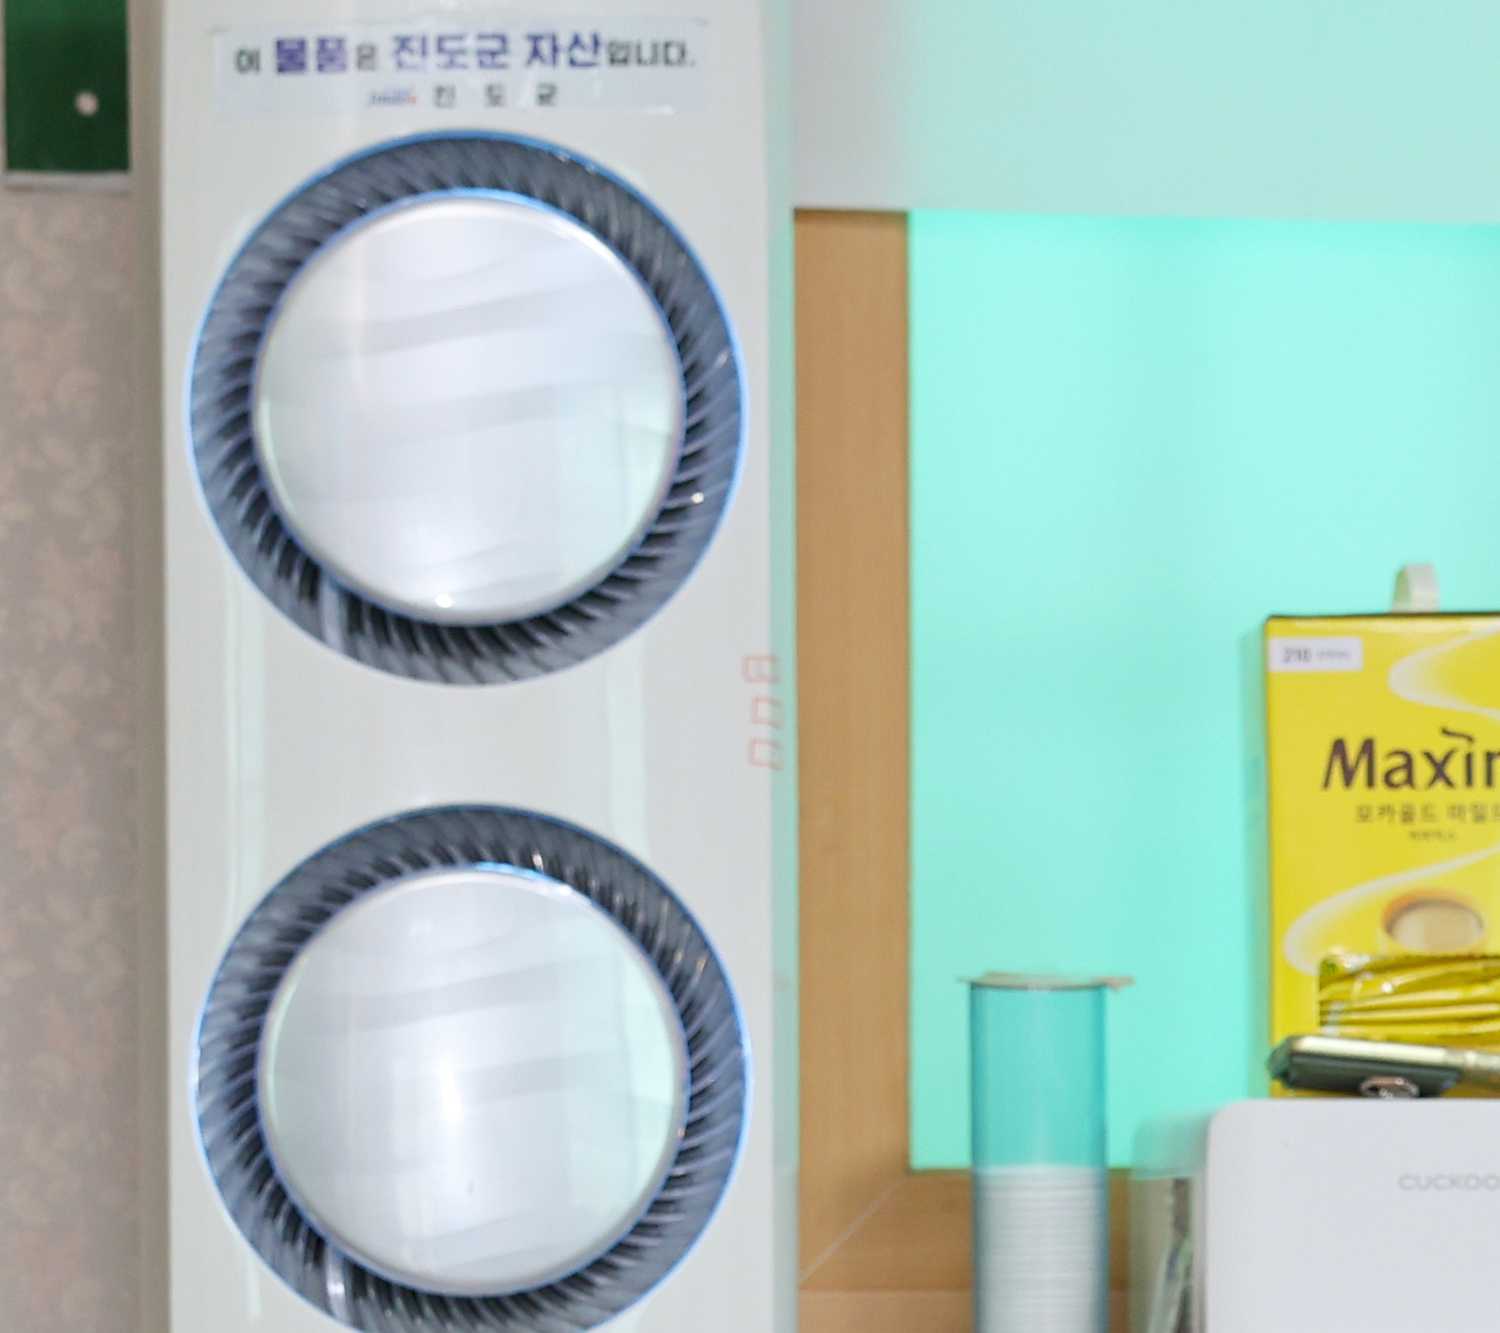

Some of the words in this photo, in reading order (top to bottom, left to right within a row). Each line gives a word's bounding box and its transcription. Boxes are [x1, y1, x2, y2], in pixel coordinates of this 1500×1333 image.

[234, 49, 262, 75] 이
[274, 35, 380, 75] 물품은
[391, 33, 511, 71] 진도군
[523, 32, 697, 70] 자산입니다.
